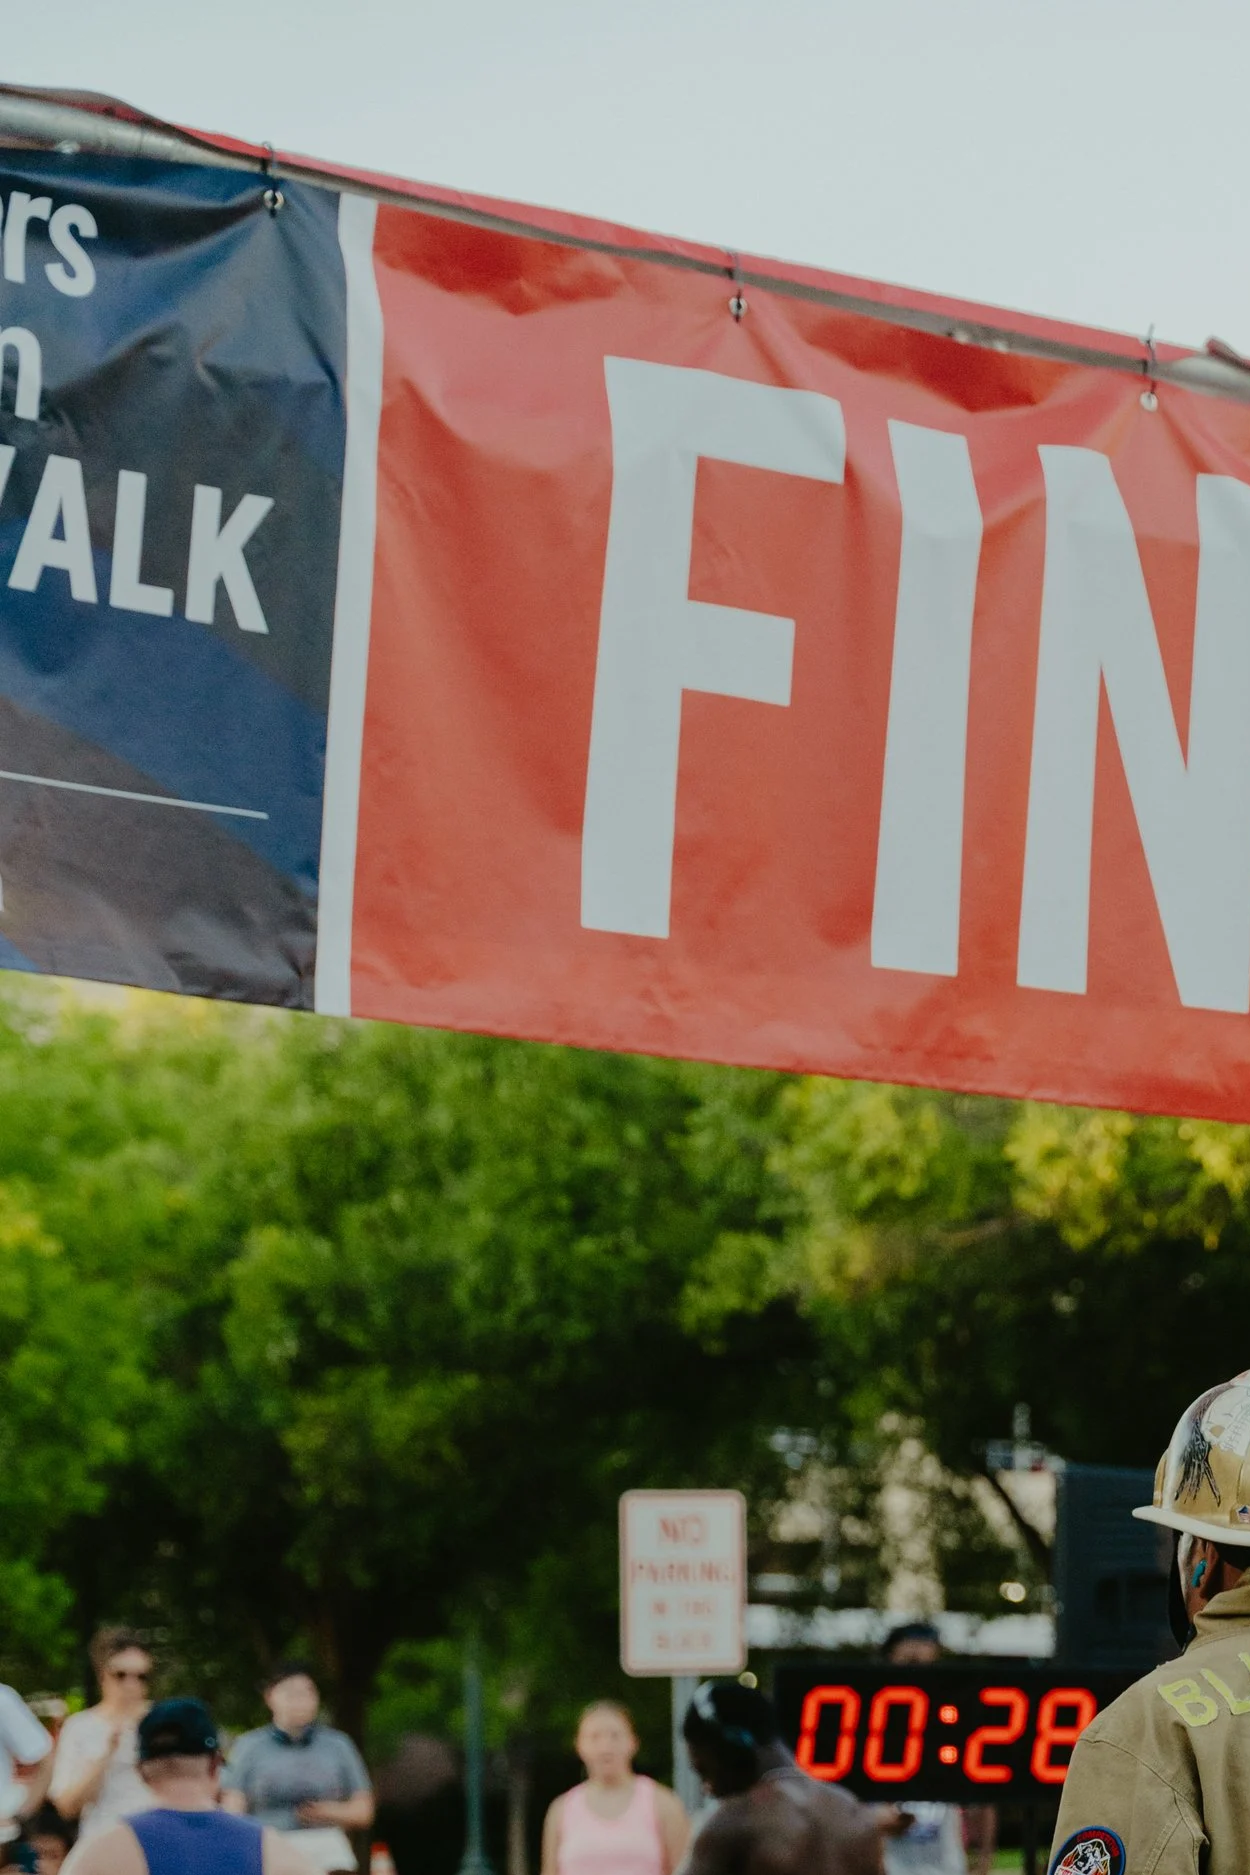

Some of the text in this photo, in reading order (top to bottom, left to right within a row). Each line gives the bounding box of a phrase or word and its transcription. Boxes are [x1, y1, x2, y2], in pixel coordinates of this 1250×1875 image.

[0, 190, 98, 298] rs
[0, 446, 274, 634] ALK
[795, 1685, 1098, 1784] 00:28
